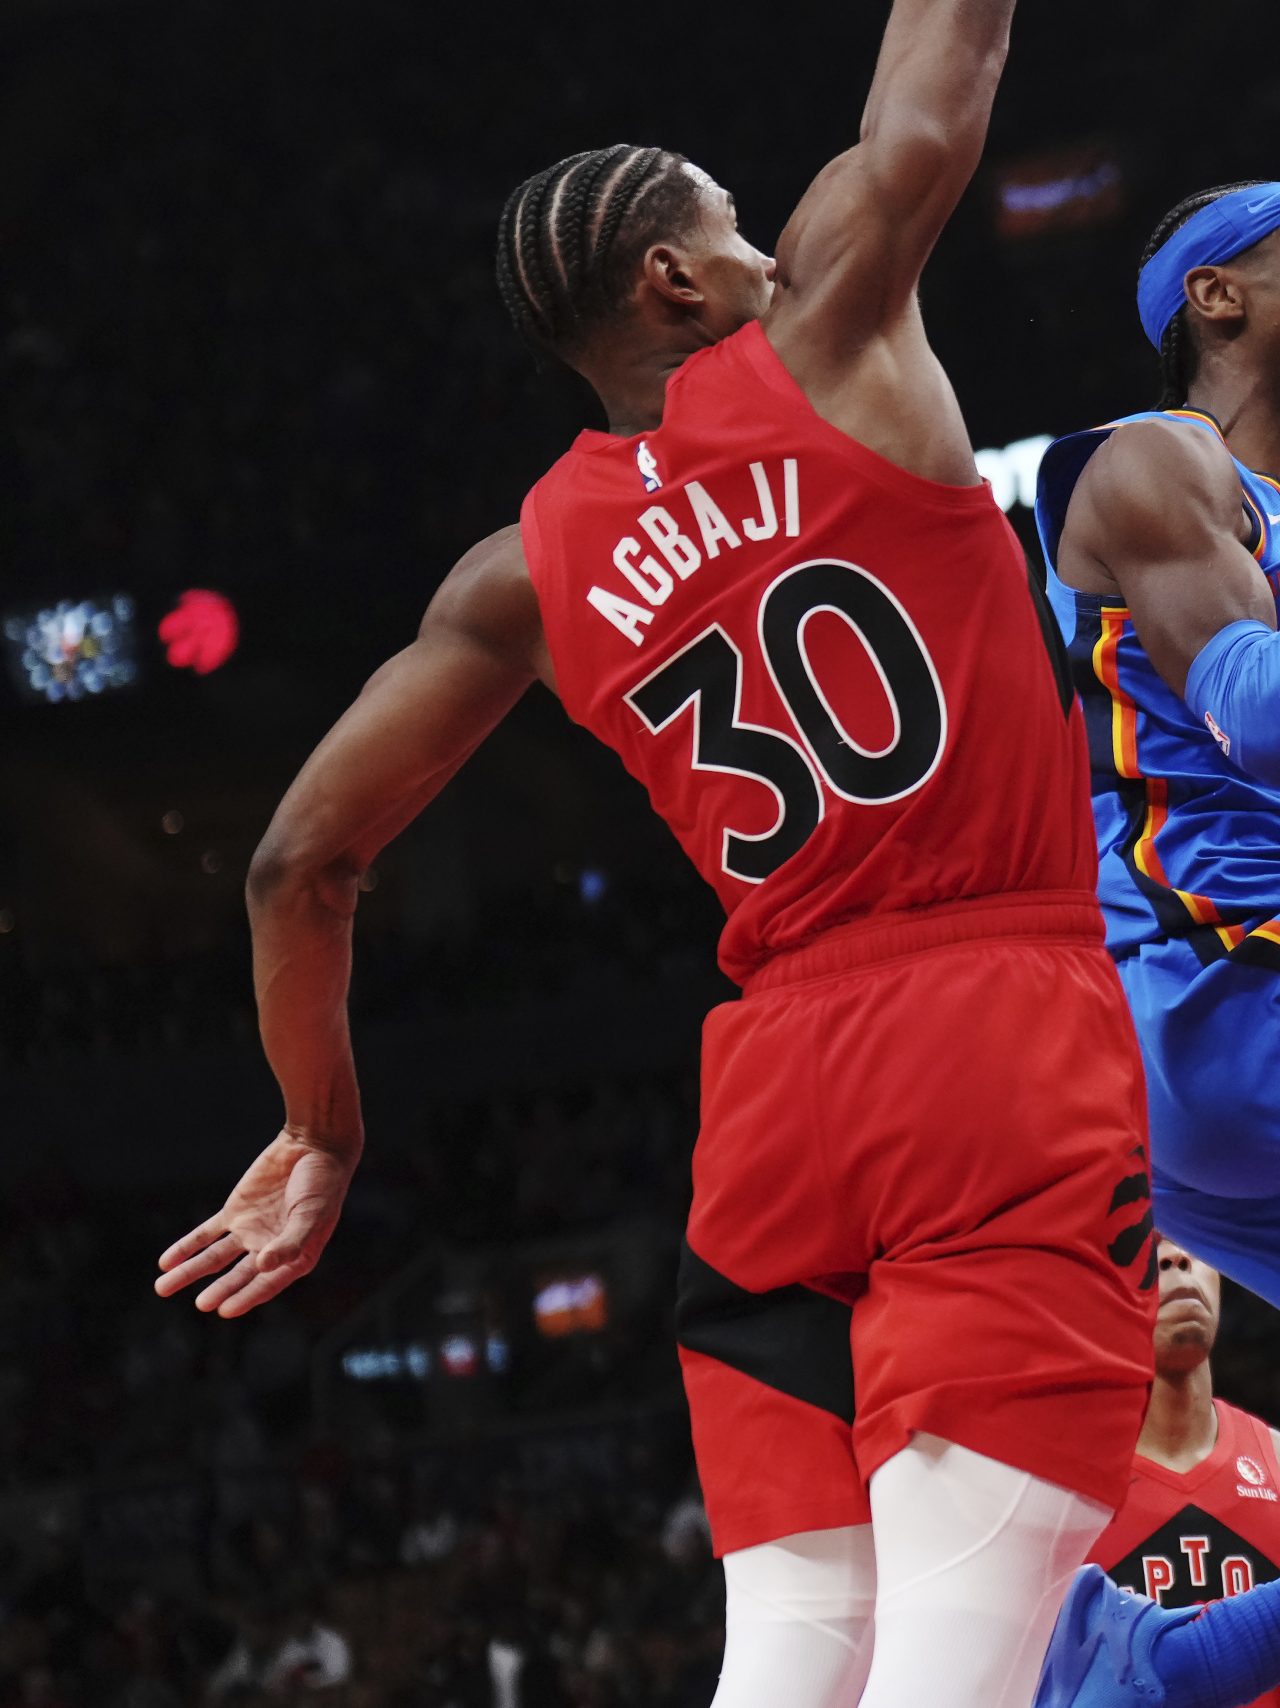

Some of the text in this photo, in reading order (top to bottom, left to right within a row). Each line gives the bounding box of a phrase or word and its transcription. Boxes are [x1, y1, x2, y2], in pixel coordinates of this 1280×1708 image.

[586, 458, 800, 647] AGBAJI
[622, 558, 948, 885] 30
[1118, 1535, 1256, 1606] PTO
